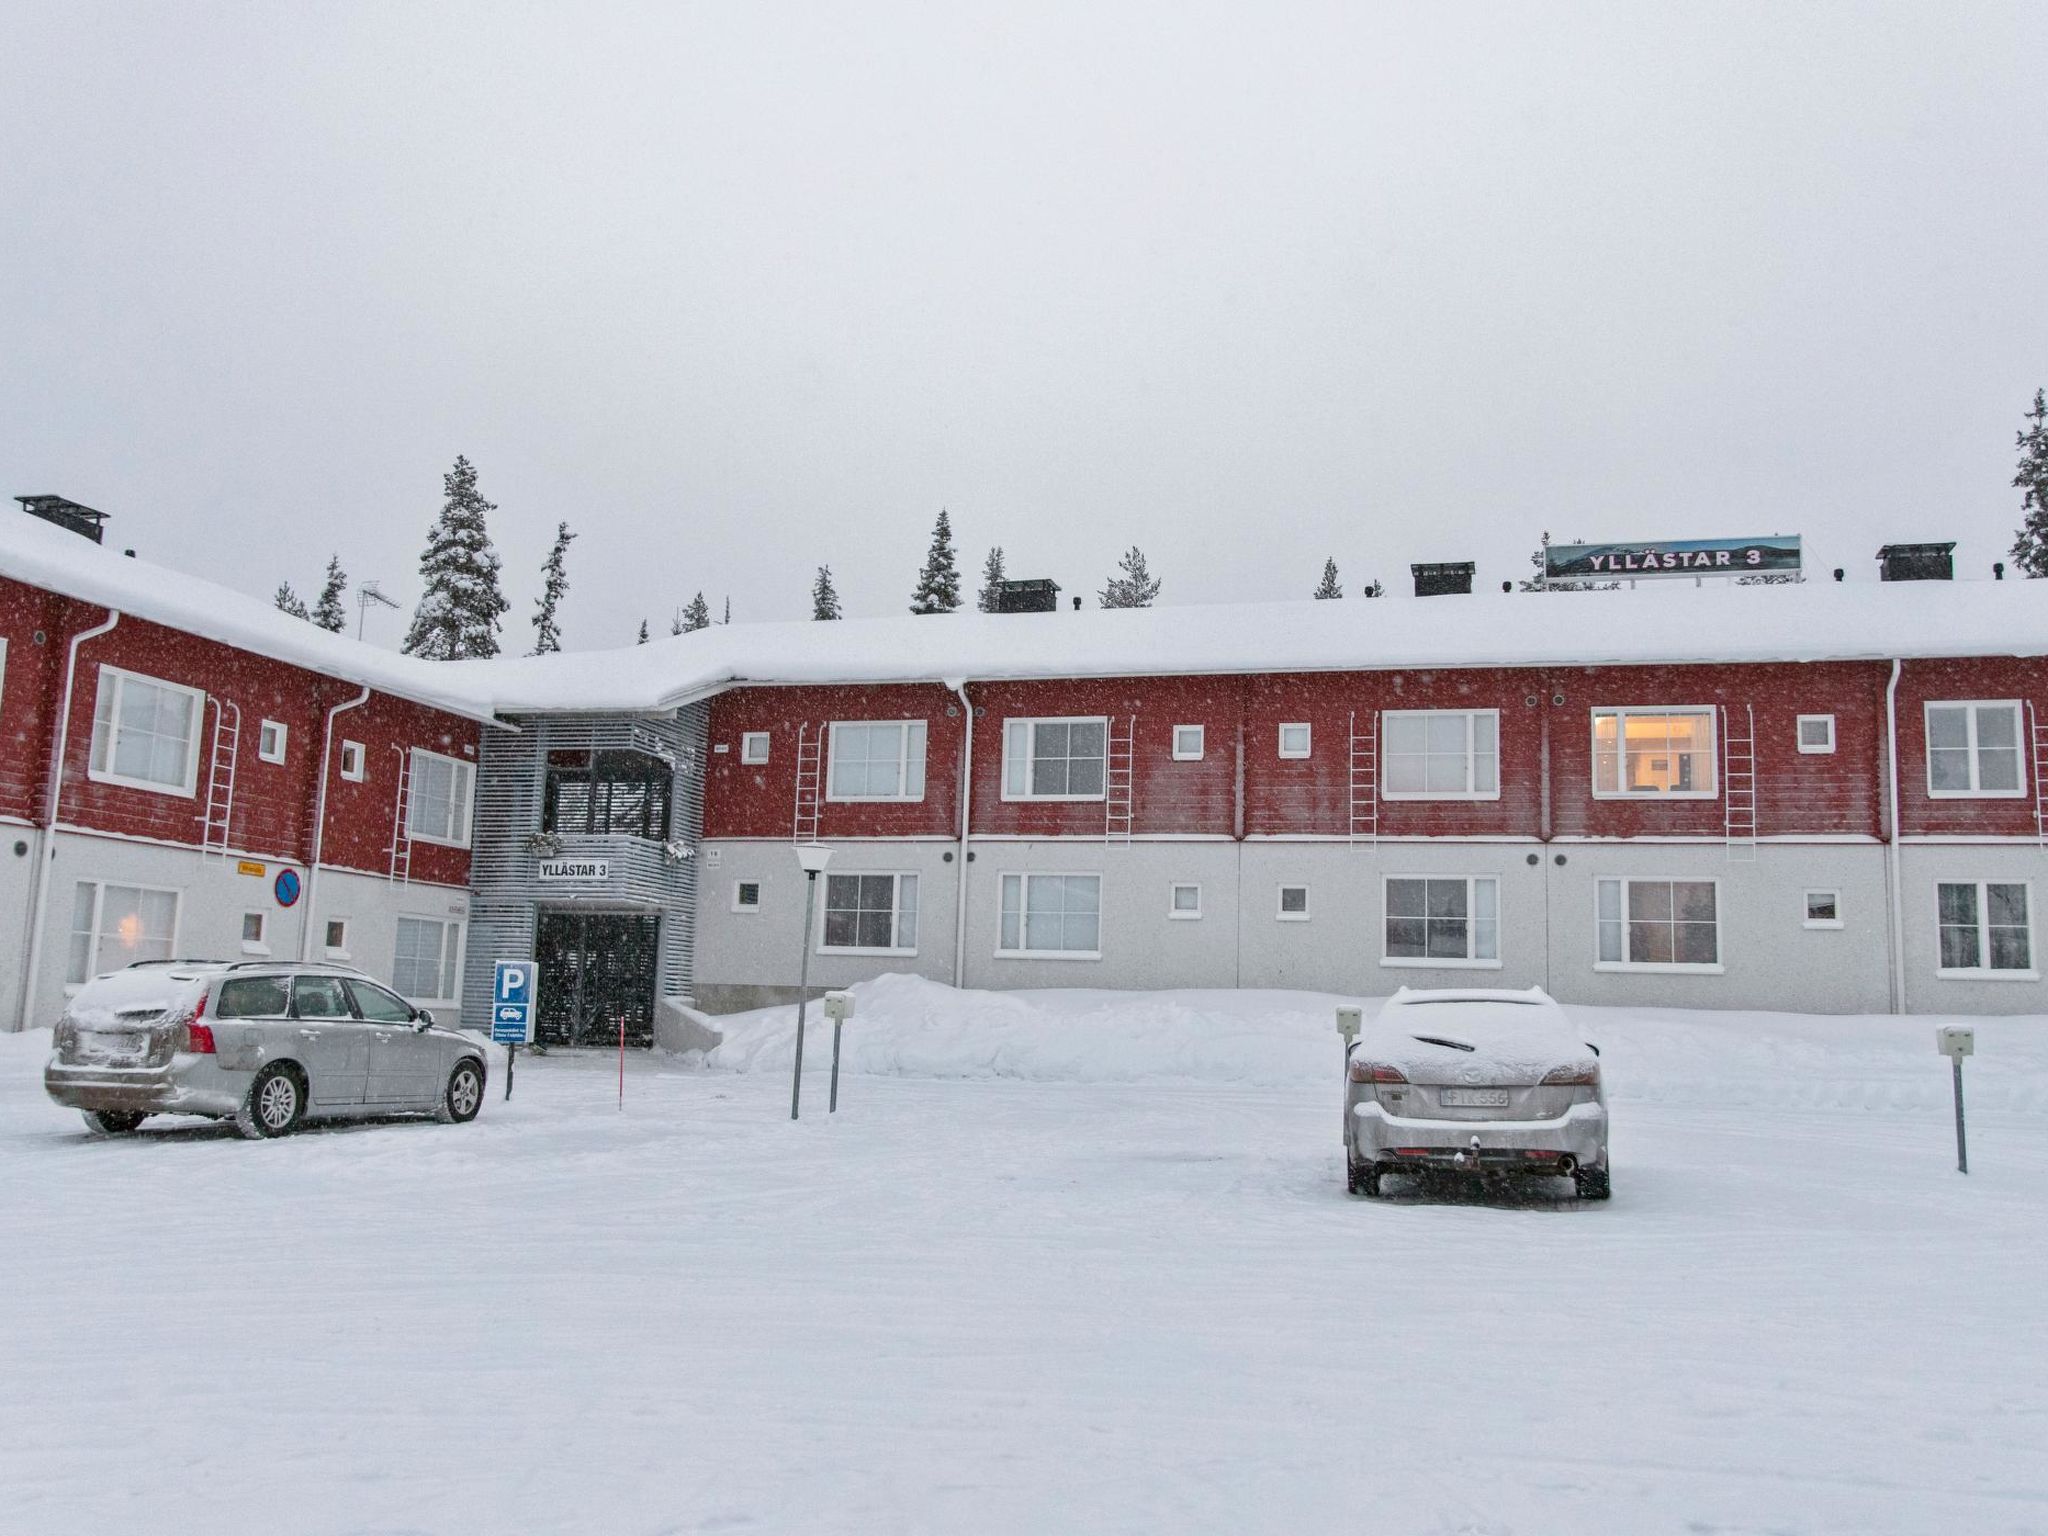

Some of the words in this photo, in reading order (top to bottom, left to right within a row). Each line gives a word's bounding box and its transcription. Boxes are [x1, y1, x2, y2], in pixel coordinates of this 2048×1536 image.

[1590, 549, 1730, 570] YLLÄSTAR
[1746, 549, 1761, 564] 3
[542, 861, 596, 876] YLLÄSTAR
[599, 864, 607, 876] 3
[502, 968, 525, 999] P
